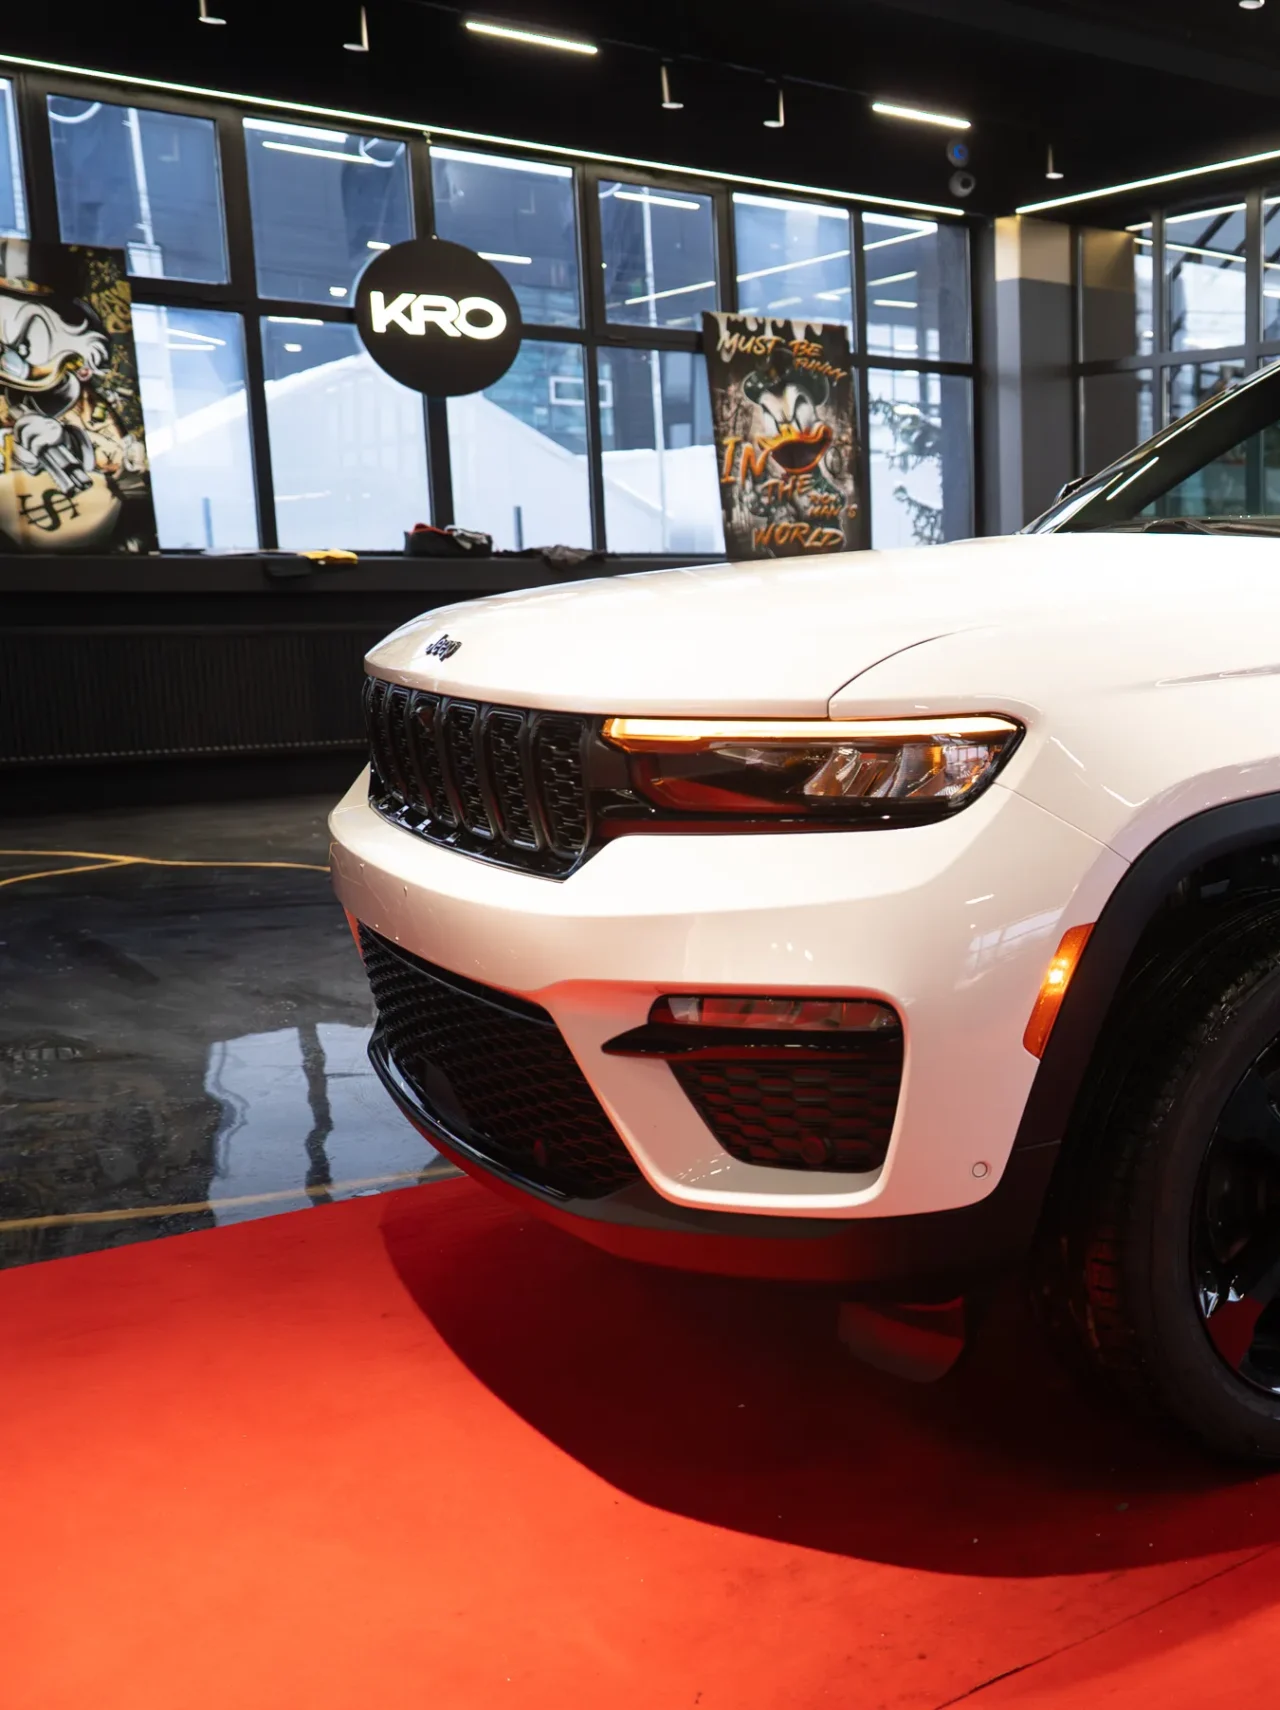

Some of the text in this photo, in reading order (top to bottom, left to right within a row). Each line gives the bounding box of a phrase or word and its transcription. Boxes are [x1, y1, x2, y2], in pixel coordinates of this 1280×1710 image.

[369, 290, 508, 341] KRO
[716, 331, 824, 357] MUST BE
[720, 437, 770, 487] IN
[757, 473, 814, 503] THE
[752, 522, 846, 549] WORLD
[425, 634, 463, 662] Jeep
